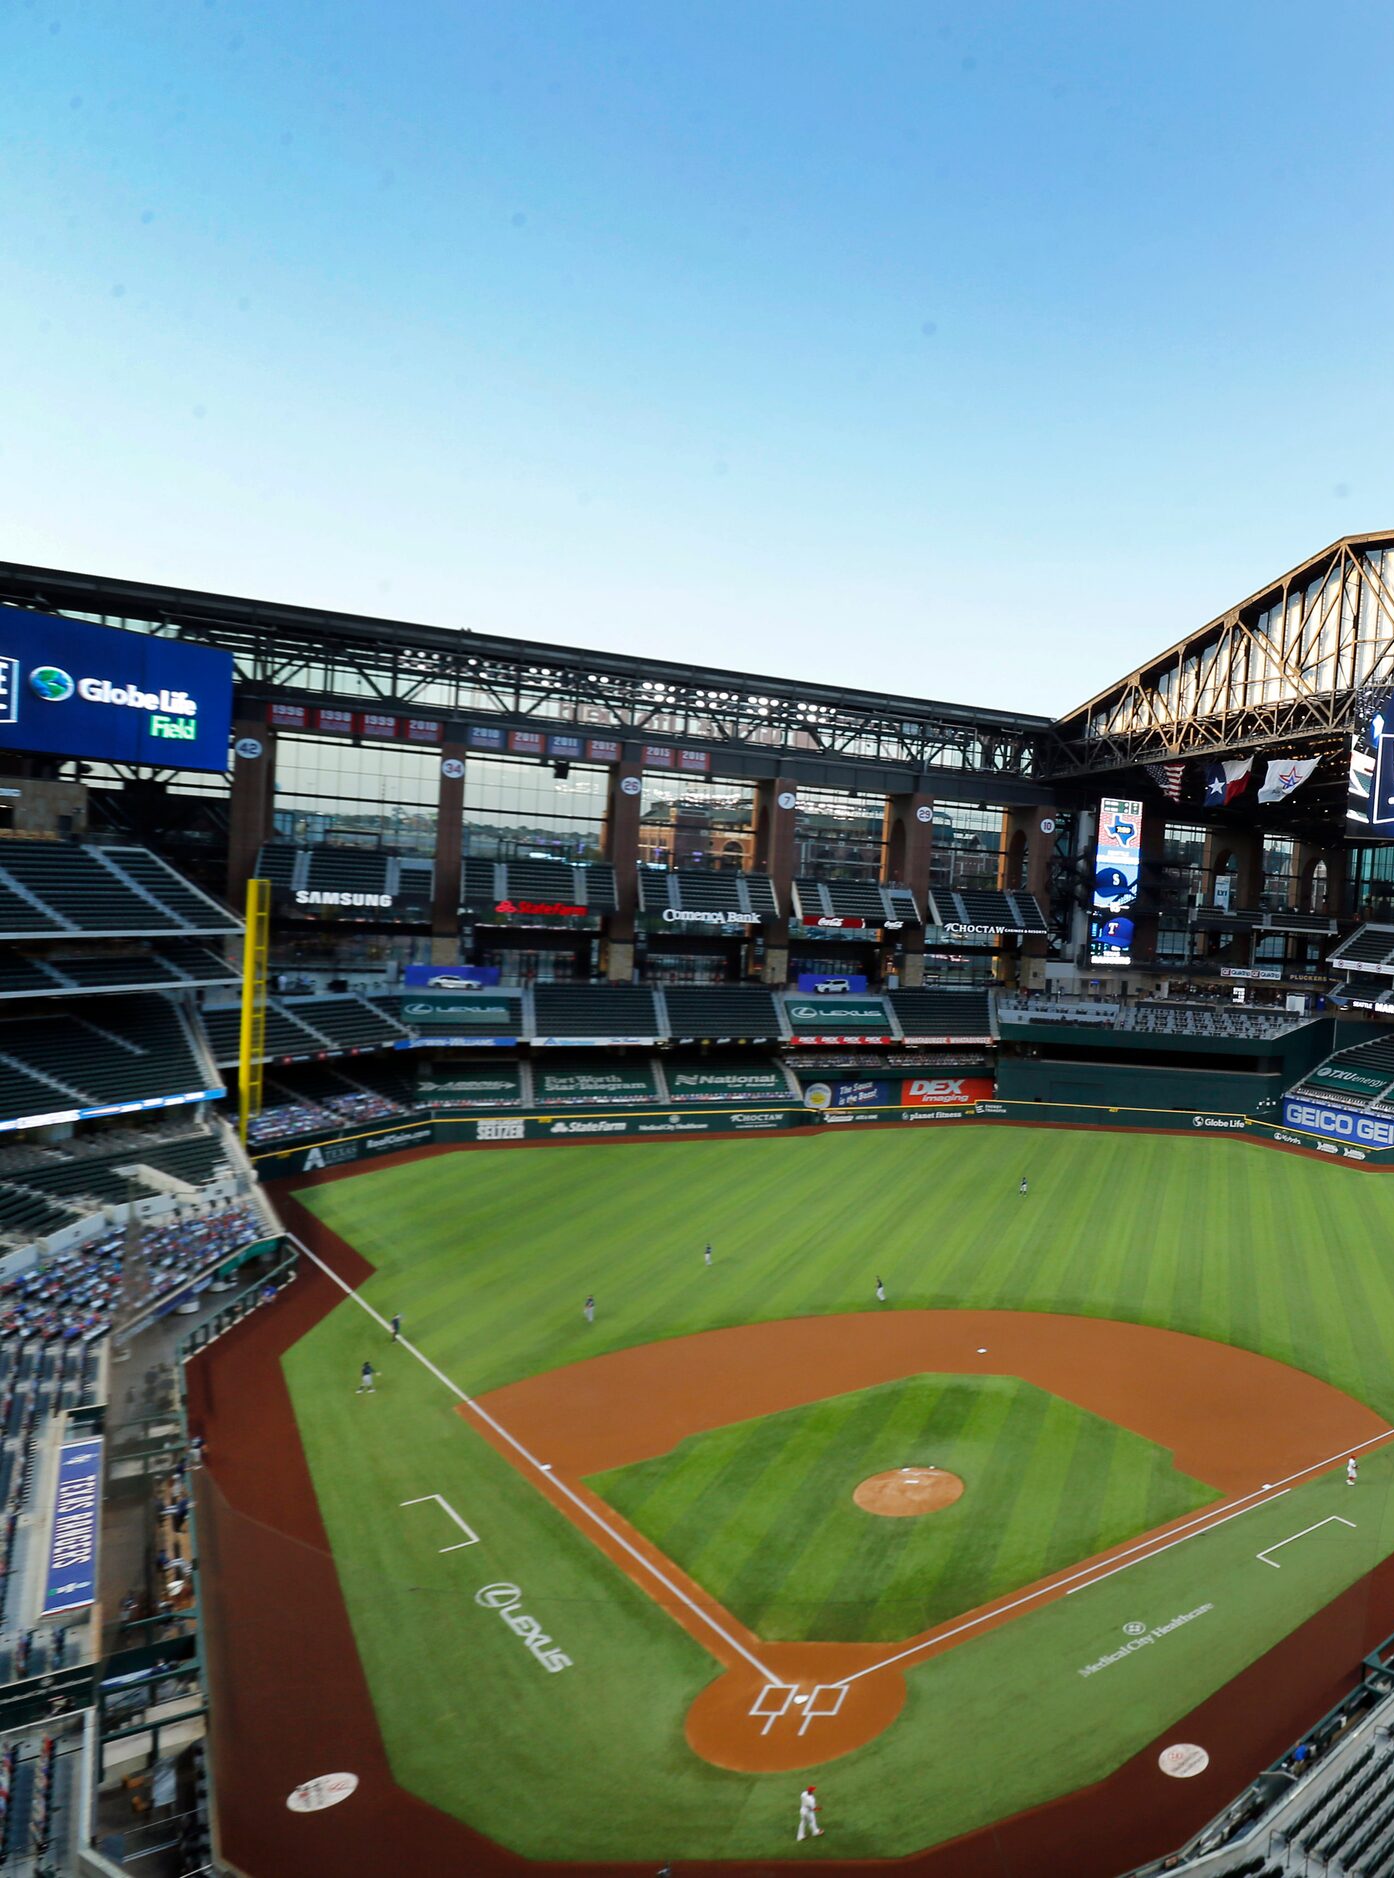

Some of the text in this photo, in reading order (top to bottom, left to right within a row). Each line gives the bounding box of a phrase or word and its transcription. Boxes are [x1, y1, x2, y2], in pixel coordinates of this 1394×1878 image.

[78, 677, 198, 716] Globe Life
[151, 715, 197, 740] Field
[409, 720, 438, 732] 2010
[472, 726, 499, 739] 2010
[514, 730, 540, 743] 2011
[554, 735, 578, 747] 2011
[238, 742, 258, 757] 42
[445, 762, 462, 775] 34
[624, 780, 638, 791] 26
[296, 890, 392, 907] SAMSUNG
[726, 911, 761, 924] Bank
[950, 922, 1005, 935] CHOCTAW
[1290, 974, 1327, 982] PLUCKERS
[819, 1009, 882, 1017] LEXUS
[699, 1074, 778, 1085] National
[909, 1079, 965, 1095] DEX
[922, 1095, 969, 1103] imaging
[735, 1113, 783, 1122] CHOCTAW
[910, 1112, 935, 1121] planet
[1204, 1118, 1228, 1128] Globe
[1229, 1119, 1245, 1128] Life
[1286, 1104, 1353, 1135] GEICO
[52, 1474, 96, 1569] TEXAS RANGERS
[499, 1603, 574, 1673] LEXUS
